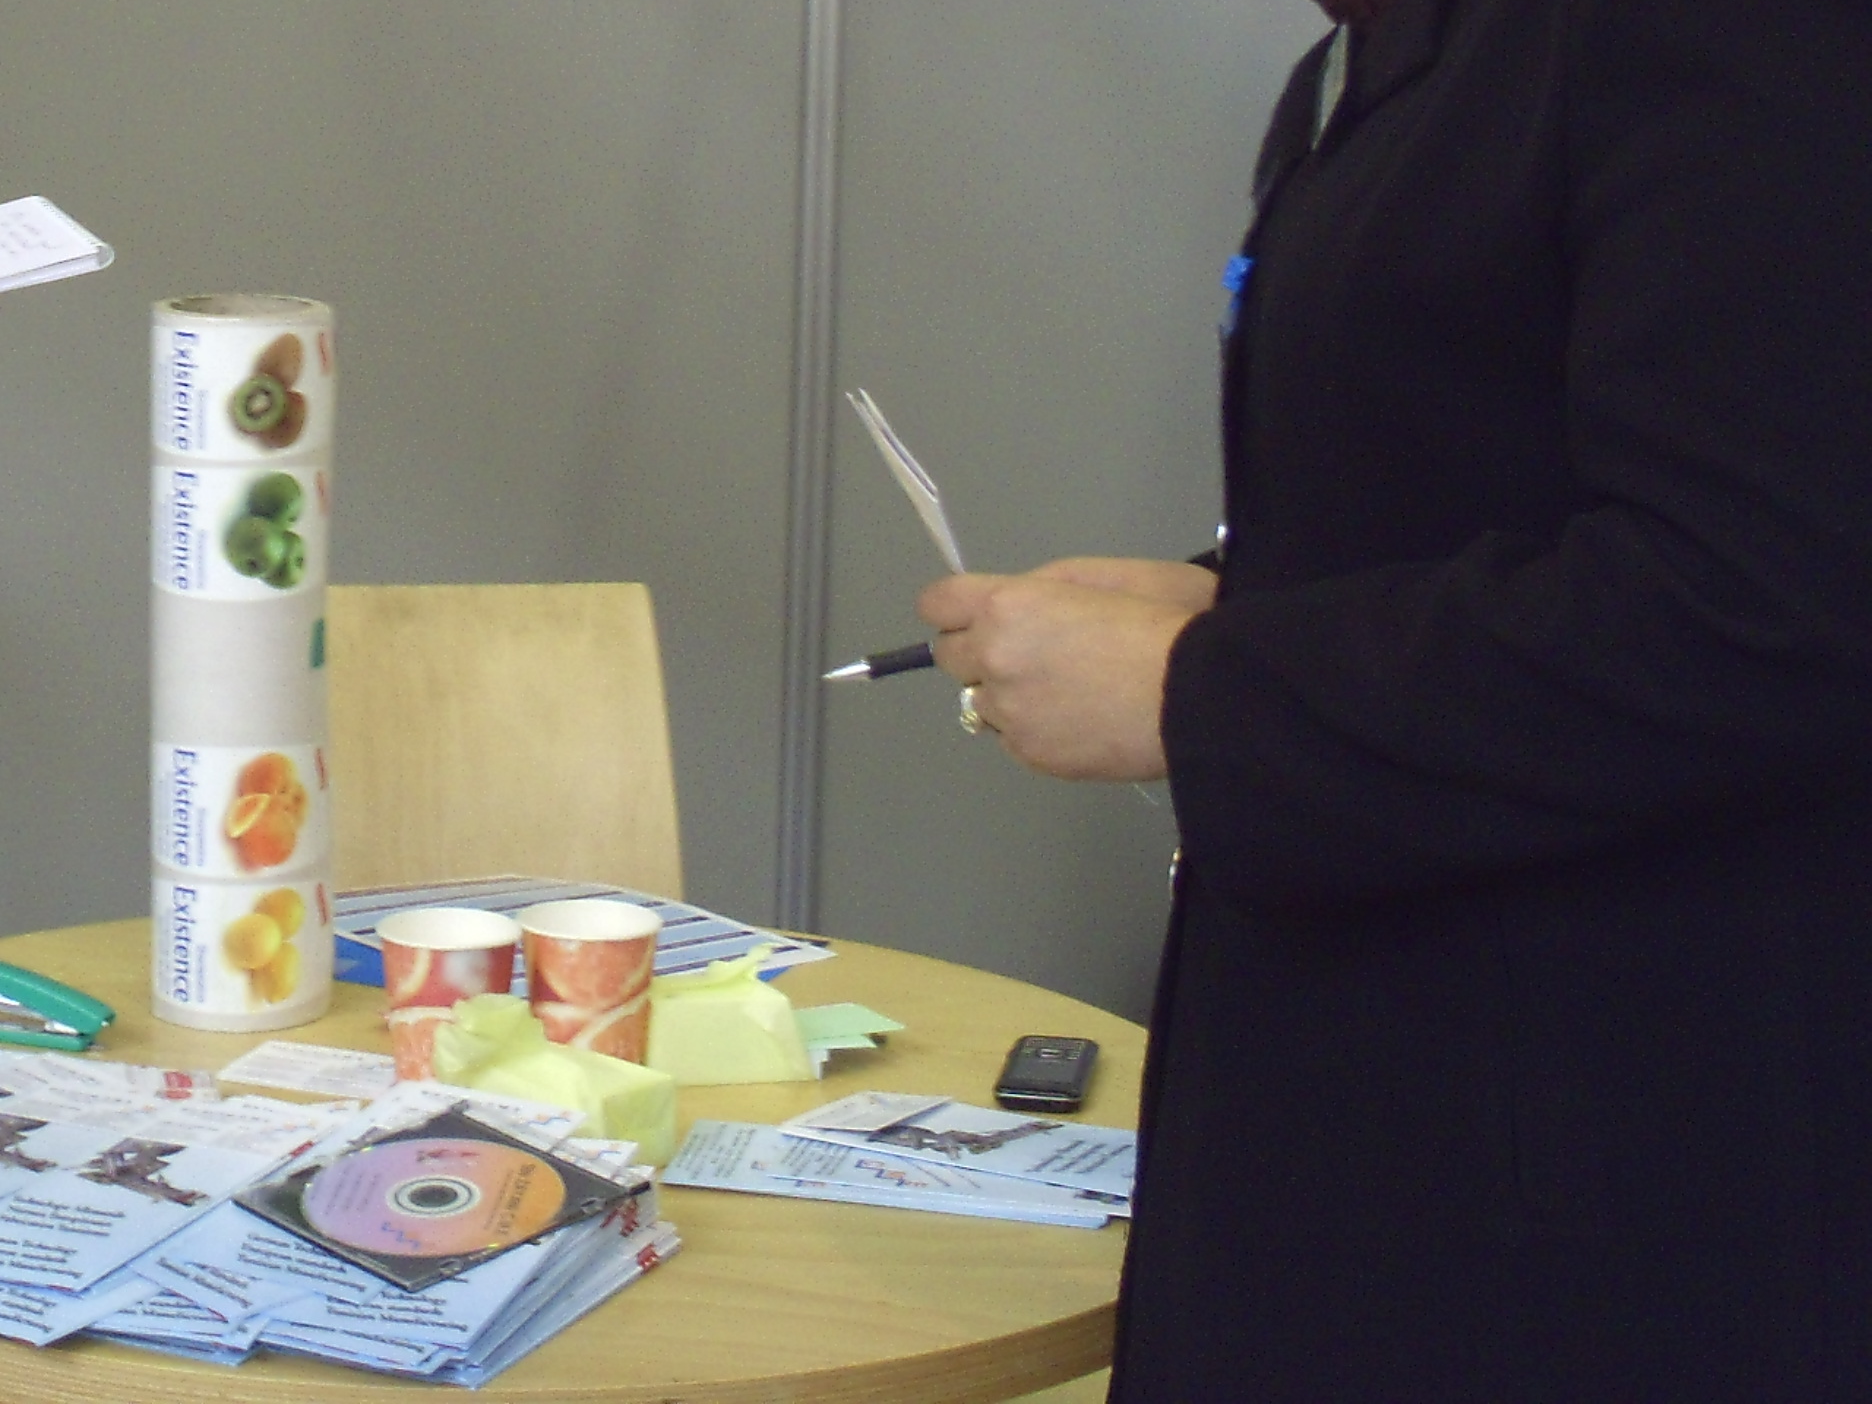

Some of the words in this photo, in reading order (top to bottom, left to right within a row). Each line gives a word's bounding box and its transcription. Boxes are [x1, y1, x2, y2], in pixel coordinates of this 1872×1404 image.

[172, 330, 199, 450] Existence
[172, 471, 199, 590] Existence
[172, 748, 198, 866] Existence
[172, 885, 197, 1002] Existence
